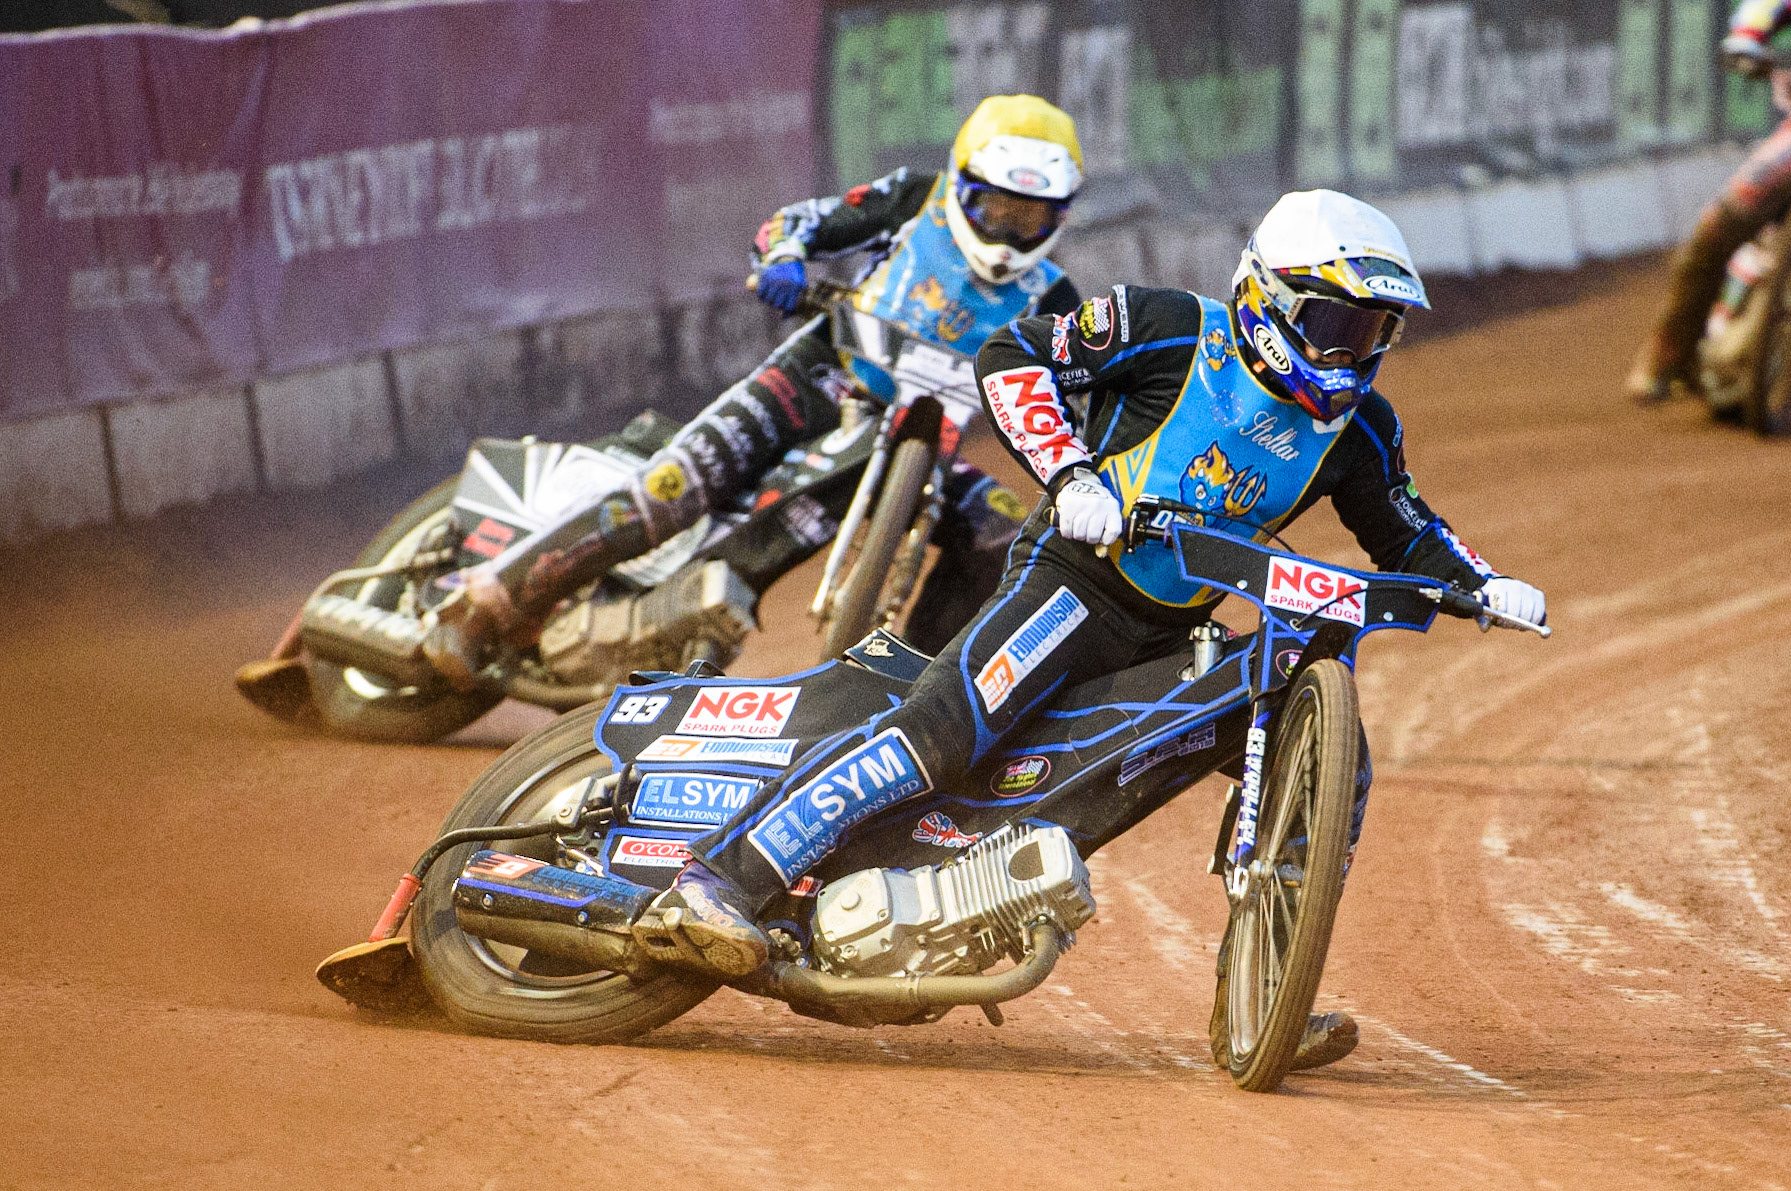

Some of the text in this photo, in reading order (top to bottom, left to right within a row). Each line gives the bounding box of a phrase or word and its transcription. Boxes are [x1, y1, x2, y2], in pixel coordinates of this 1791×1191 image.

[1366, 276, 1417, 297] Arai
[1258, 330, 1289, 371] Arai
[986, 380, 1048, 479] SPARK PLUGS
[1002, 371, 1088, 465] NGK
[1239, 411, 1300, 462] Stellar
[1272, 563, 1361, 610] NGK
[1270, 594, 1313, 610] SPARK
[1021, 606, 1087, 671] ELECTRICAL
[610, 695, 671, 723] 93
[689, 692, 793, 722] NGK
[682, 723, 778, 734] SPARK PLUGS
[644, 779, 750, 809] ELSYM
[764, 744, 906, 859] ELSYM
[890, 779, 919, 800] LTD
[636, 806, 720, 821] INSTALLATIONS
